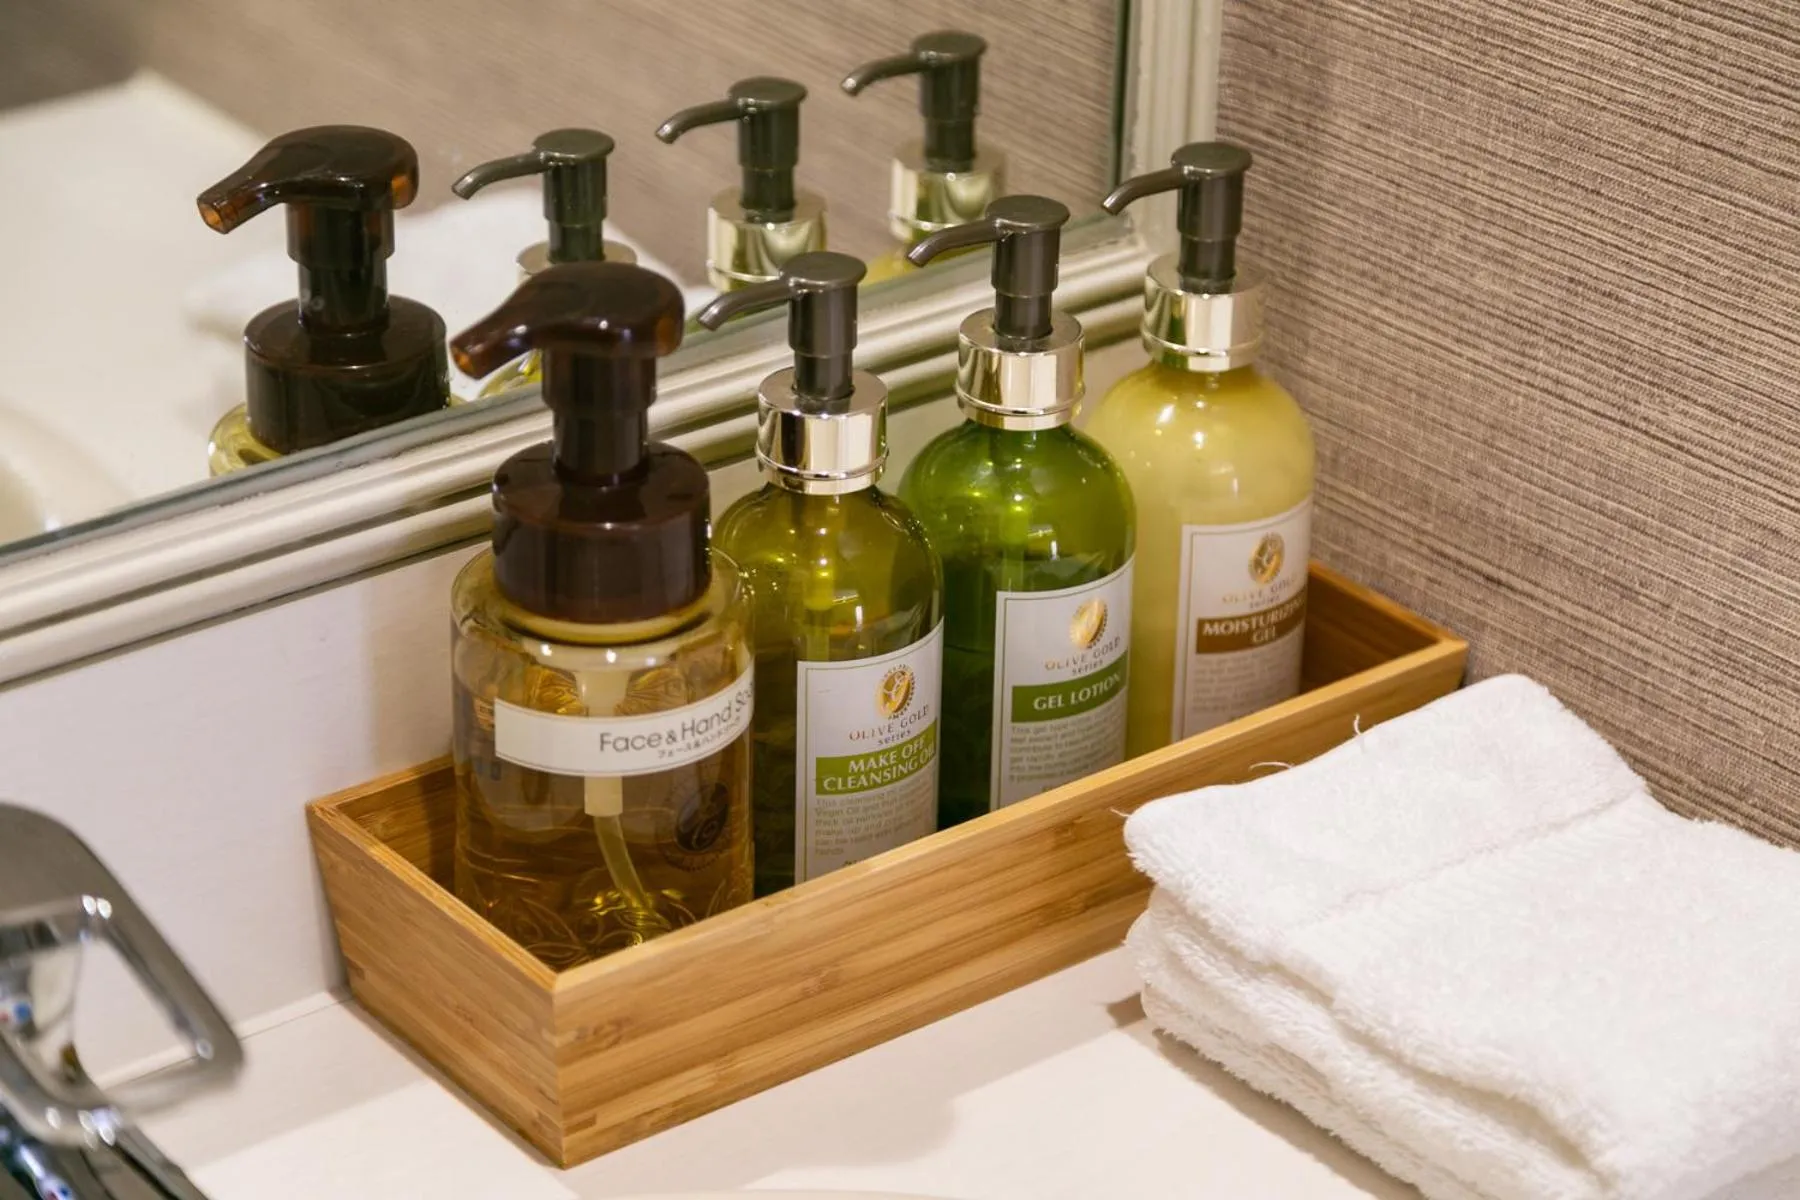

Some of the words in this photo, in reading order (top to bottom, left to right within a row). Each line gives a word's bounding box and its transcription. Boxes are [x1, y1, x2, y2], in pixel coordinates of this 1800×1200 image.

[1252, 626, 1277, 643] GEL
[1044, 652, 1088, 671] OLIVE
[1072, 659, 1103, 676] series
[1033, 693, 1065, 711] GEL
[599, 731, 663, 753] Face
[665, 729, 678, 746] &
[681, 701, 733, 741] Hand
[849, 722, 895, 741] OLIVE
[878, 729, 911, 746] series
[848, 749, 898, 774] MAKE
[901, 738, 925, 759] OFF
[823, 756, 919, 792] CLEANSING
